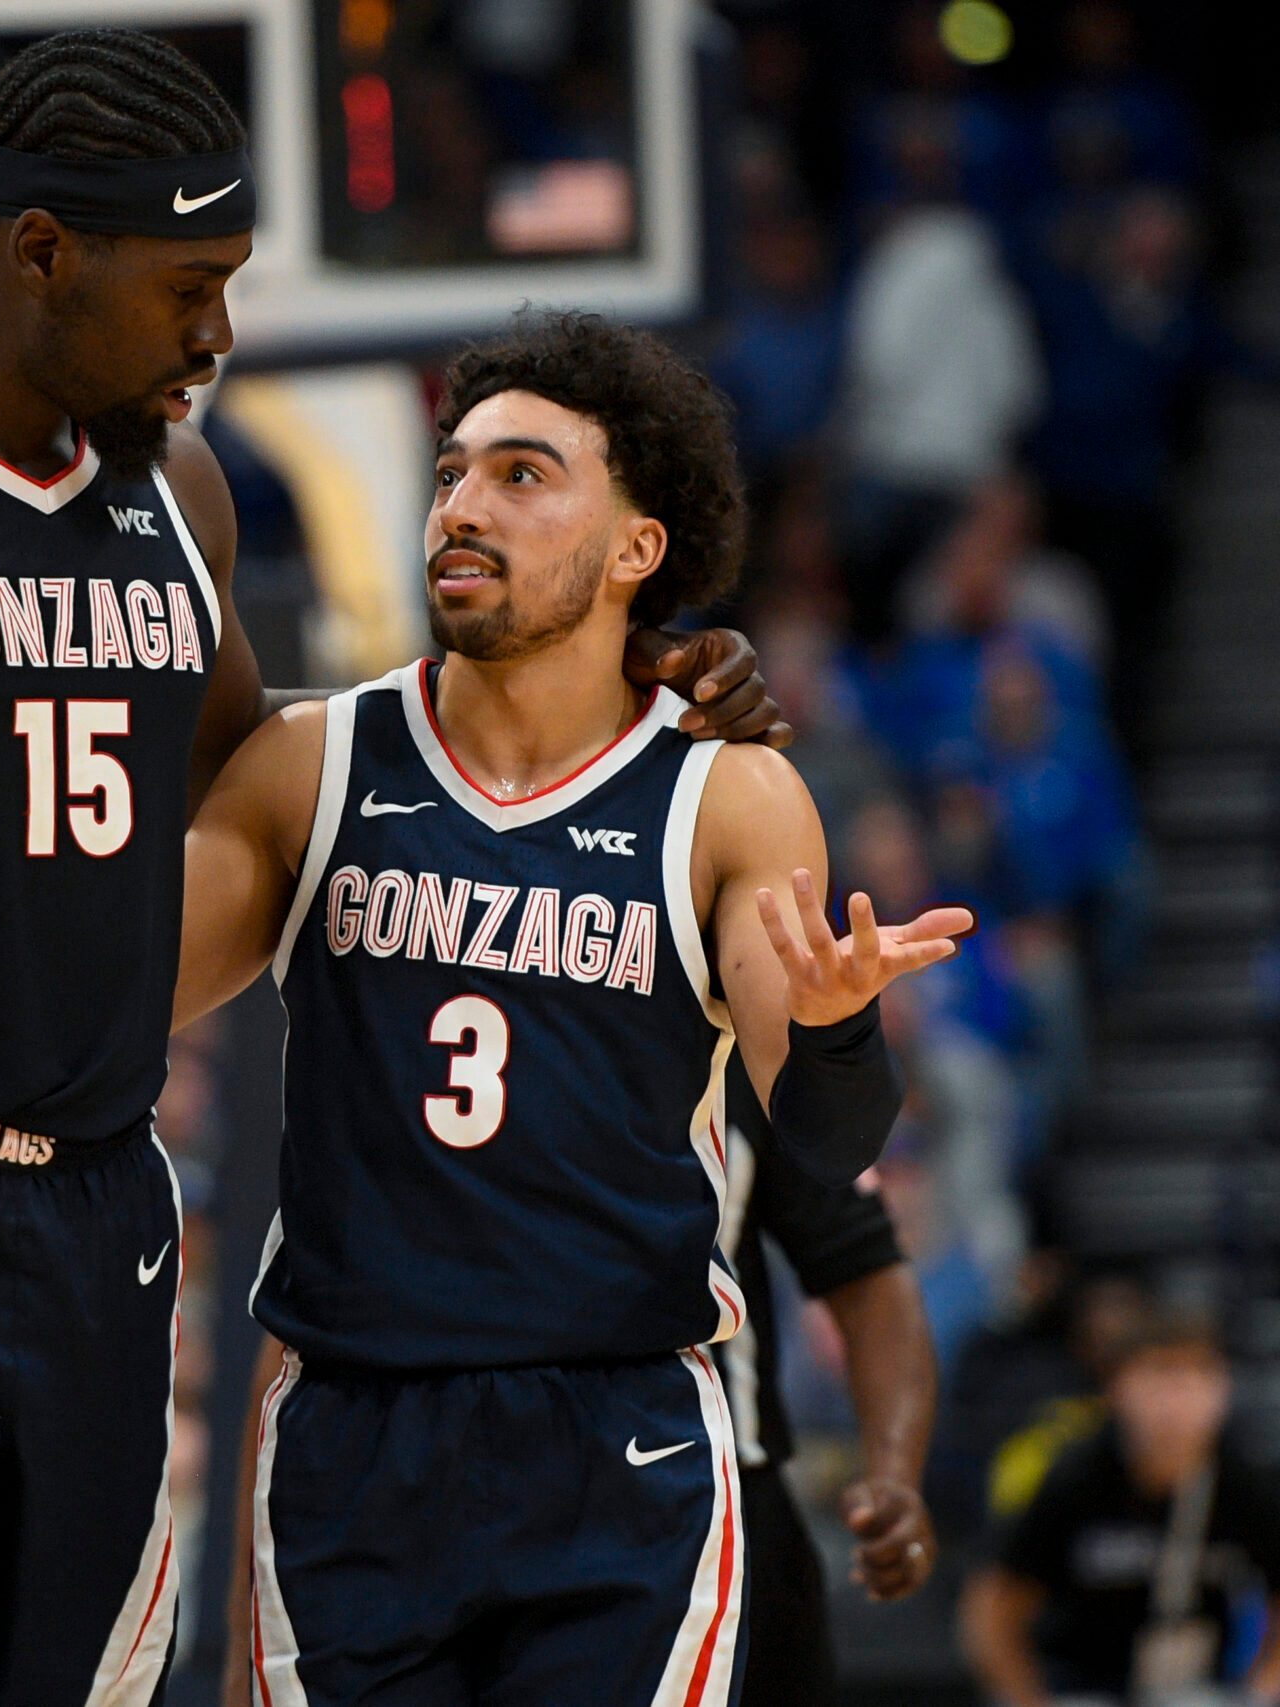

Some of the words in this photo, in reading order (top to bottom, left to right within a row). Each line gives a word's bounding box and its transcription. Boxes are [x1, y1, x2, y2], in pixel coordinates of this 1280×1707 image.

[107, 505, 161, 538] WCC
[13, 698, 135, 859] 15
[566, 826, 638, 856] WCC
[326, 864, 658, 997] GONZAGA
[423, 993, 511, 1150] 3
